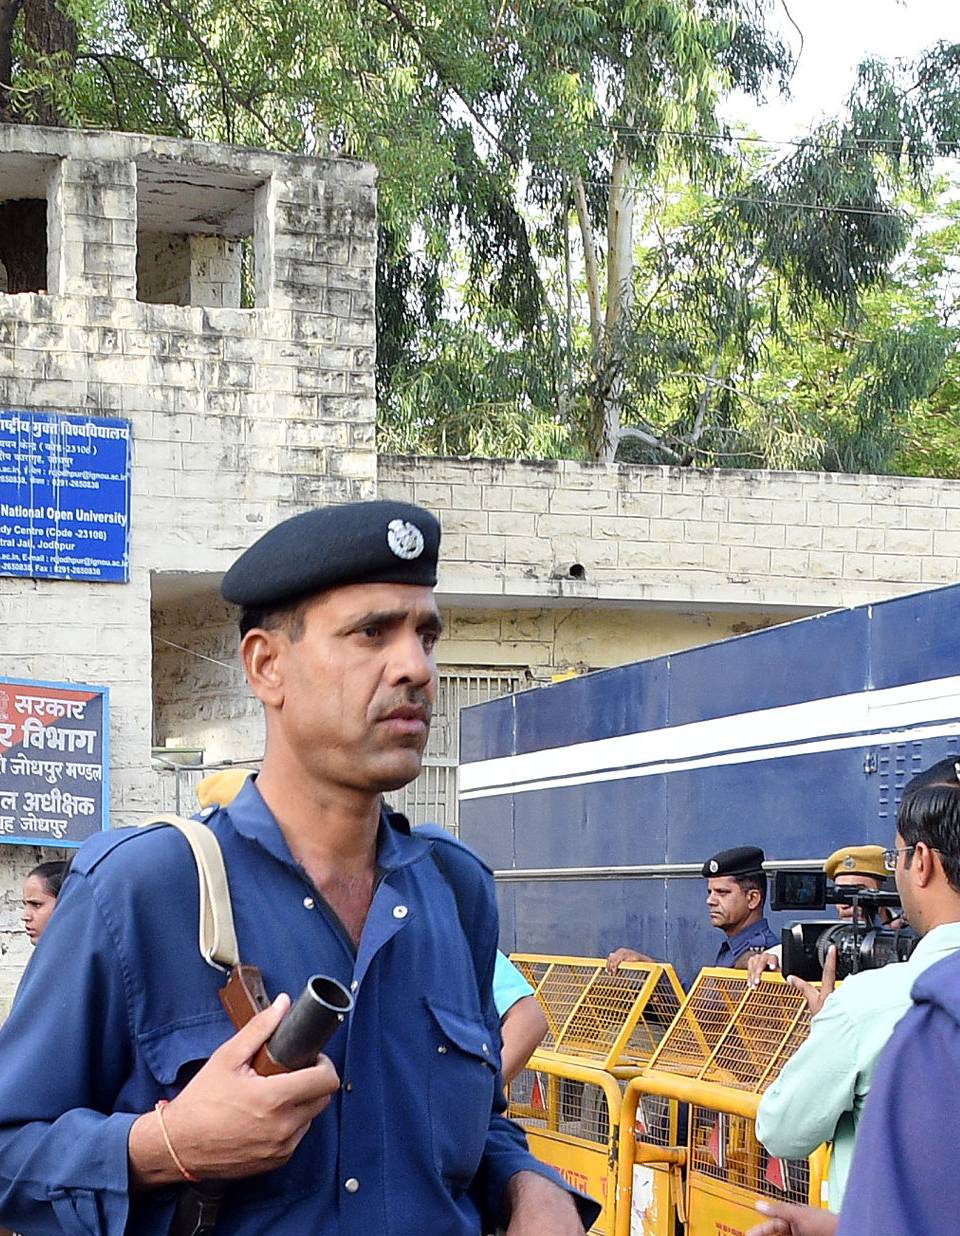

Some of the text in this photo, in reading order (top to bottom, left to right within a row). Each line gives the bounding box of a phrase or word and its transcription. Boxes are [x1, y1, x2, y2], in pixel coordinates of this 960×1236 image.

[1, 504, 127, 527] National Open University
[14, 525, 44, 536] Centre
[37, 540, 76, 552] Jodhpur
[14, 695, 87, 720] सरकार
[21, 716, 97, 754] विभाग
[10, 752, 64, 784] जोधपुर
[65, 762, 102, 782] मण्डल
[23, 787, 95, 818] अधीक्षक
[20, 812, 68, 839] जोधपुर
